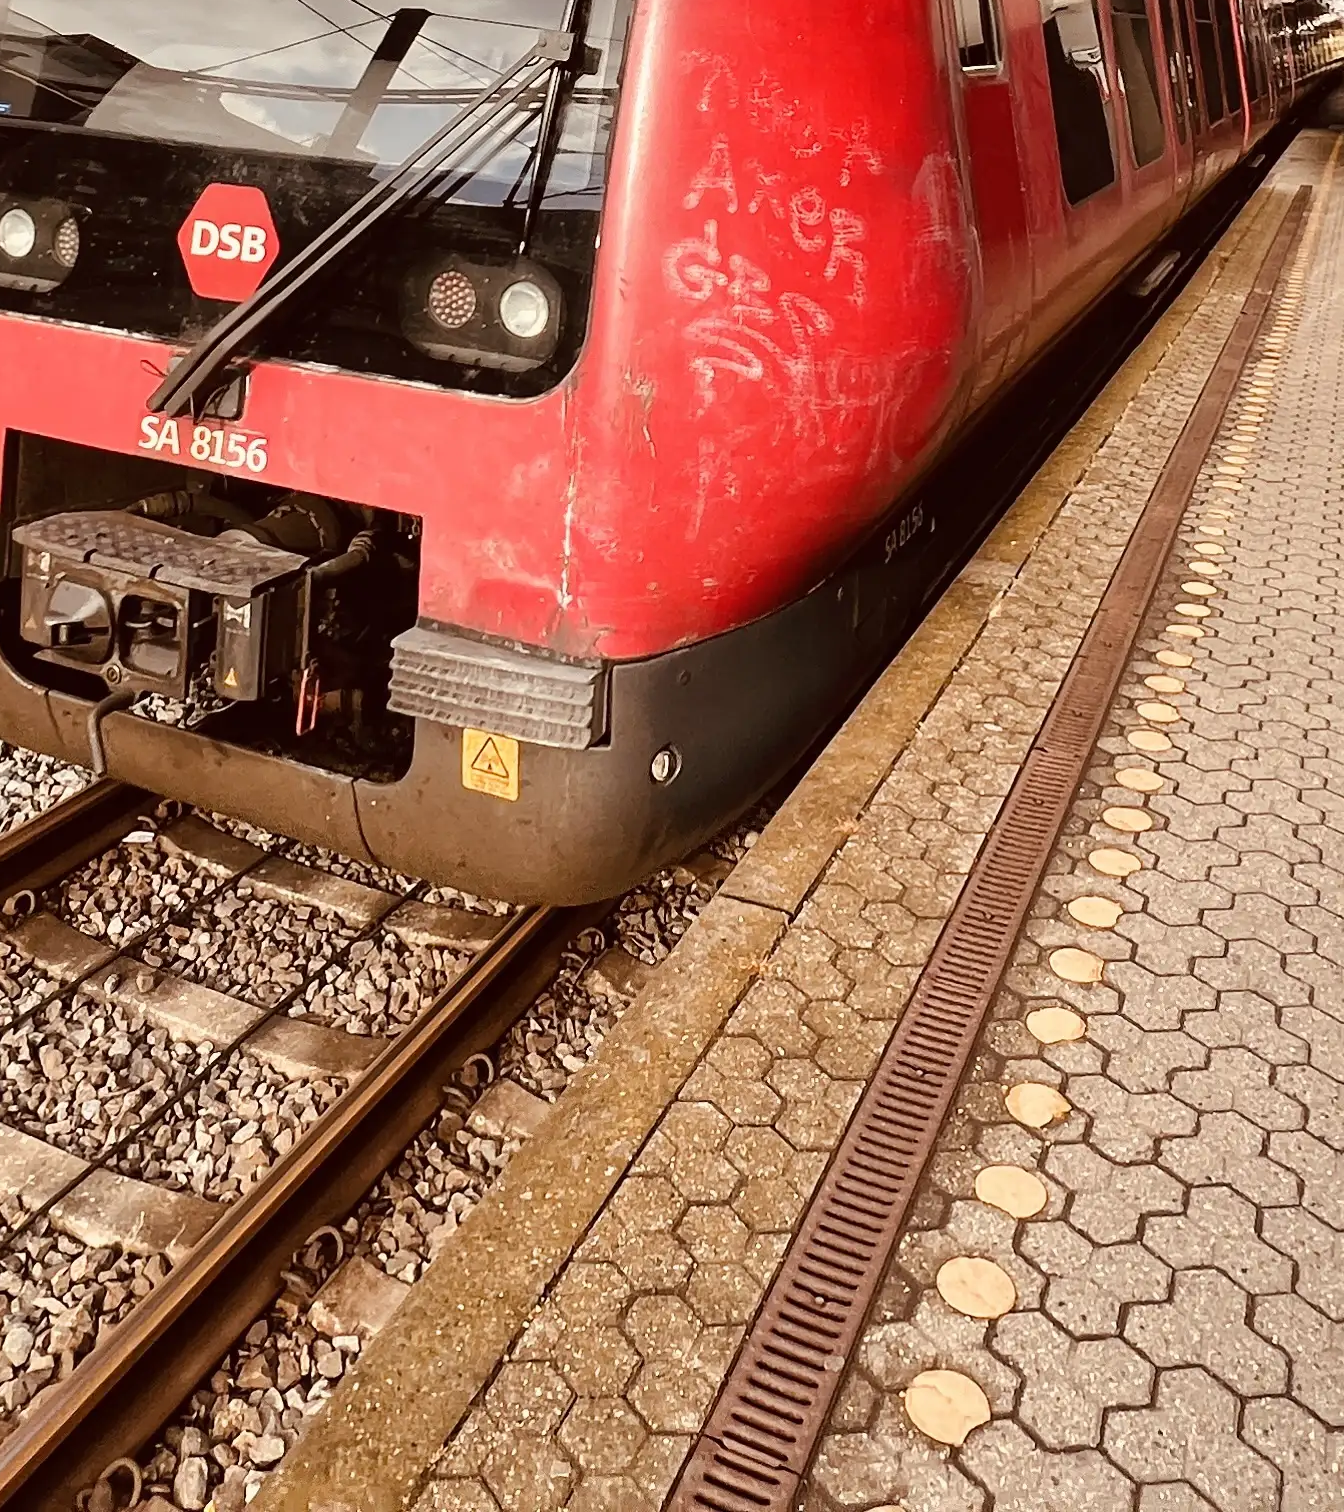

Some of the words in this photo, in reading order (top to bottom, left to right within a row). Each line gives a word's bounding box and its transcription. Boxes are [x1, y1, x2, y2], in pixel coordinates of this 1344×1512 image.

[190, 219, 267, 263] DSB
[138, 415, 181, 455] SA
[190, 426, 268, 473] 8156
